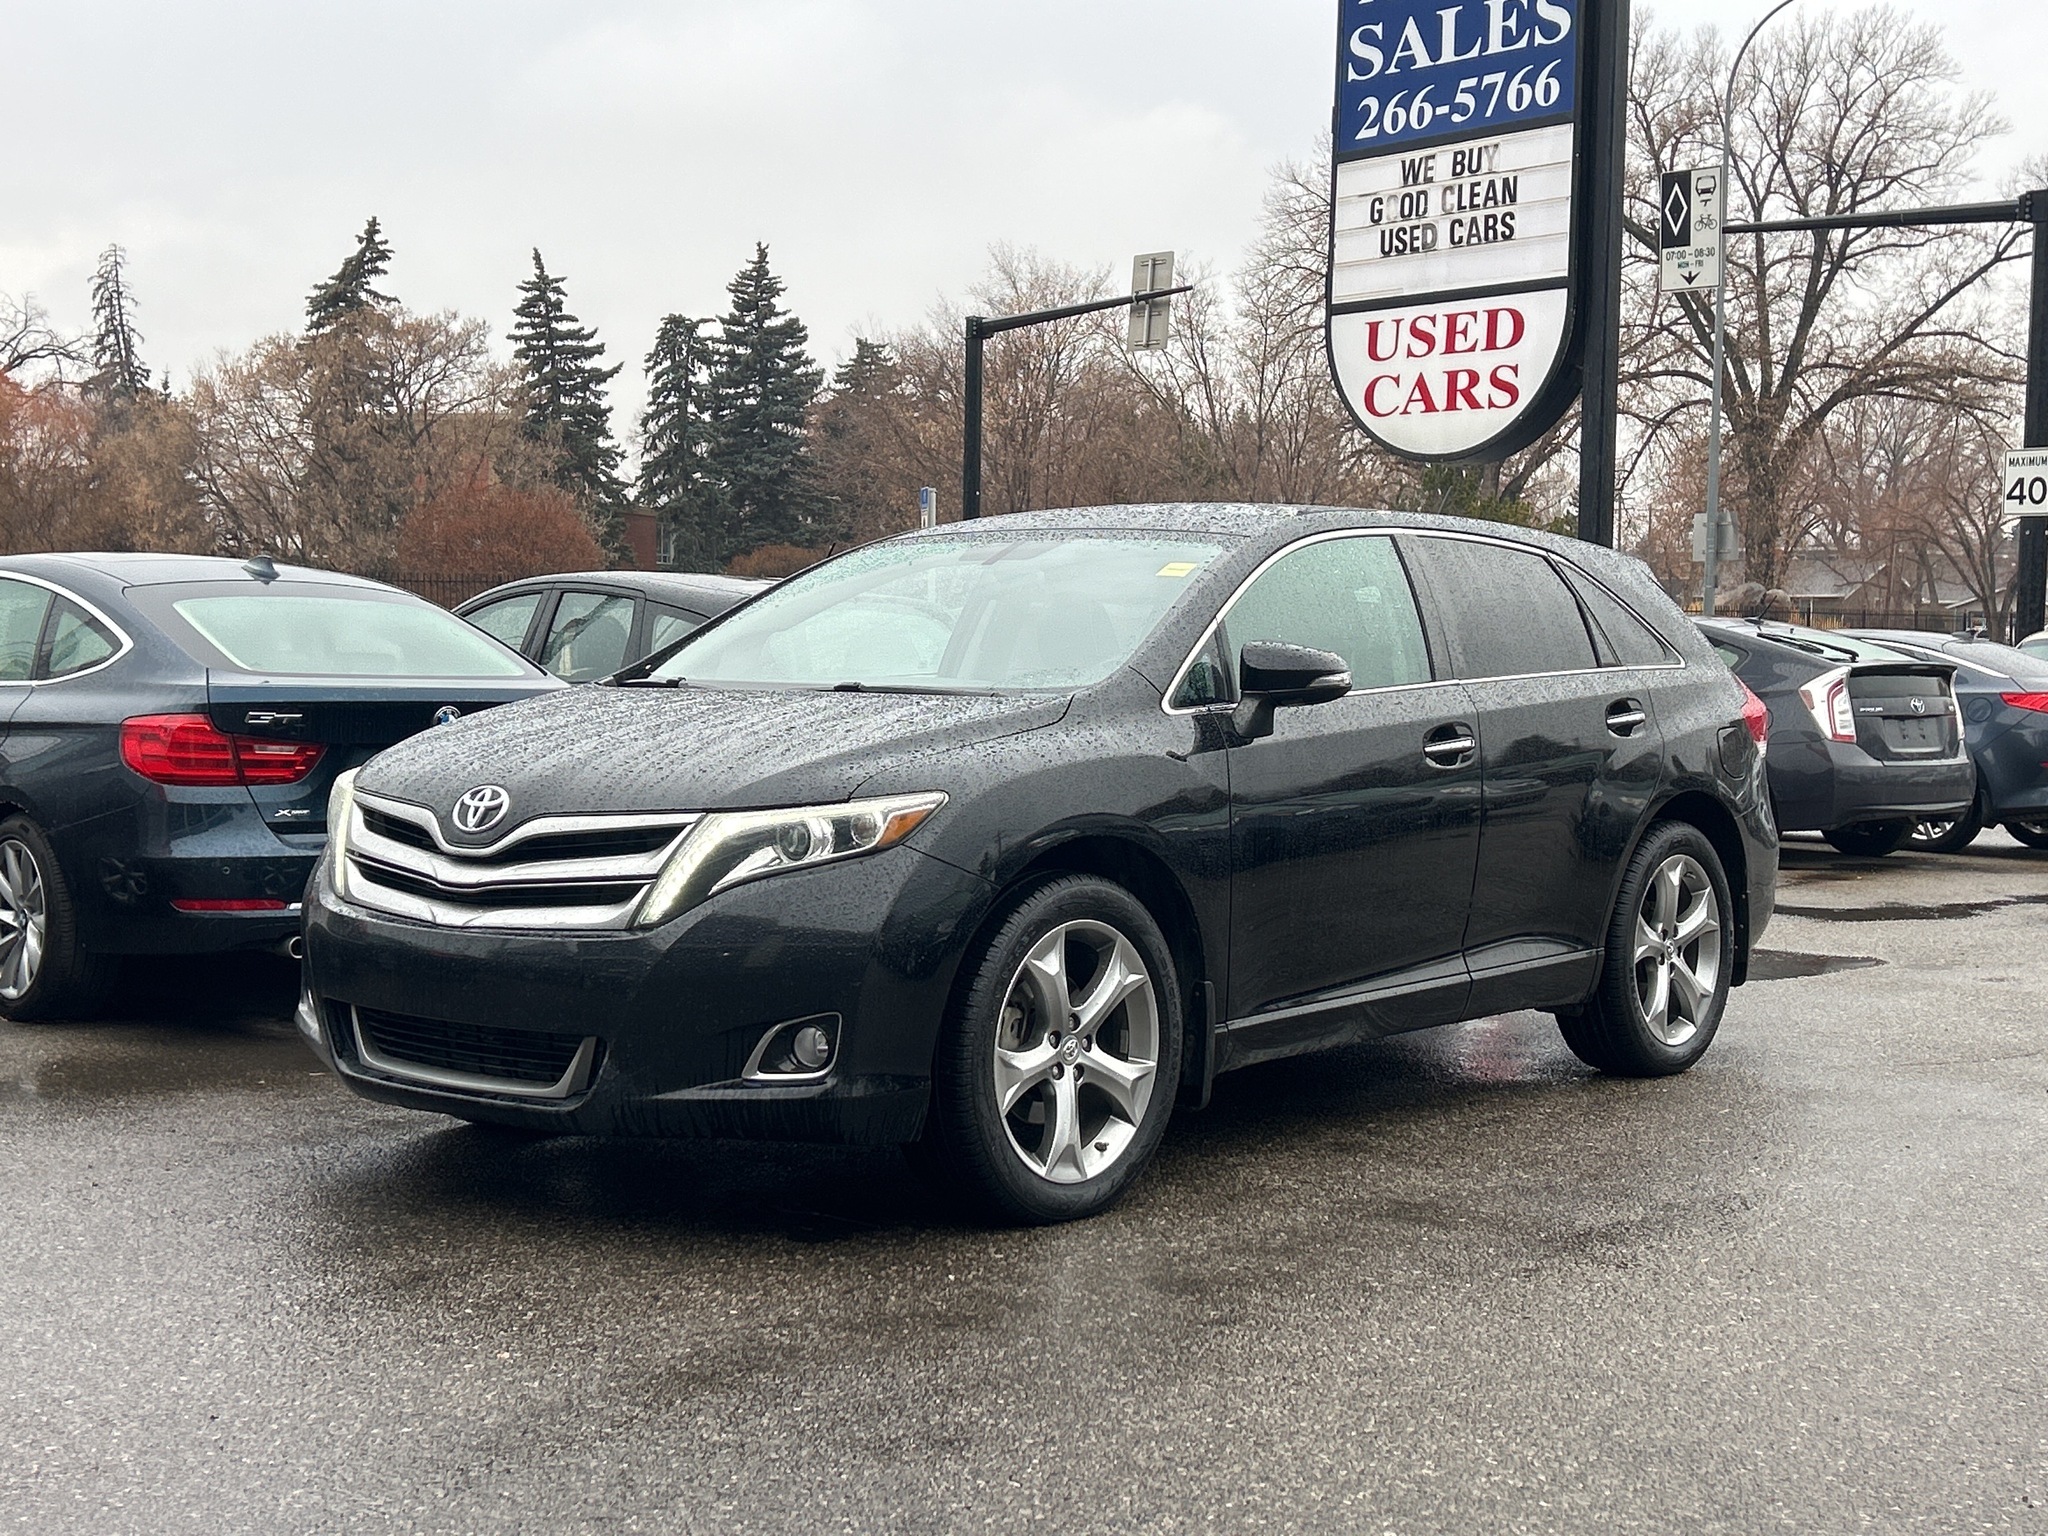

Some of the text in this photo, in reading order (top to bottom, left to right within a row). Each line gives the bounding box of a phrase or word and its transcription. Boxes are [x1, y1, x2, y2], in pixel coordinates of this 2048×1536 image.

[1347, 0, 1572, 82] SALES
[1354, 59, 1562, 140] 266-5766
[1400, 144, 1499, 186] WE BUY
[1370, 176, 1518, 223] GOOD CLEAN
[1380, 211, 1516, 257] USED CARS
[1665, 250, 1687, 261] 07:00
[1694, 247, 1715, 258] 08:30
[1365, 307, 1525, 362] USED
[1363, 364, 1519, 417] CARS
[2008, 456, 2047, 467] MAXIMUM
[2006, 476, 2047, 505] 40
